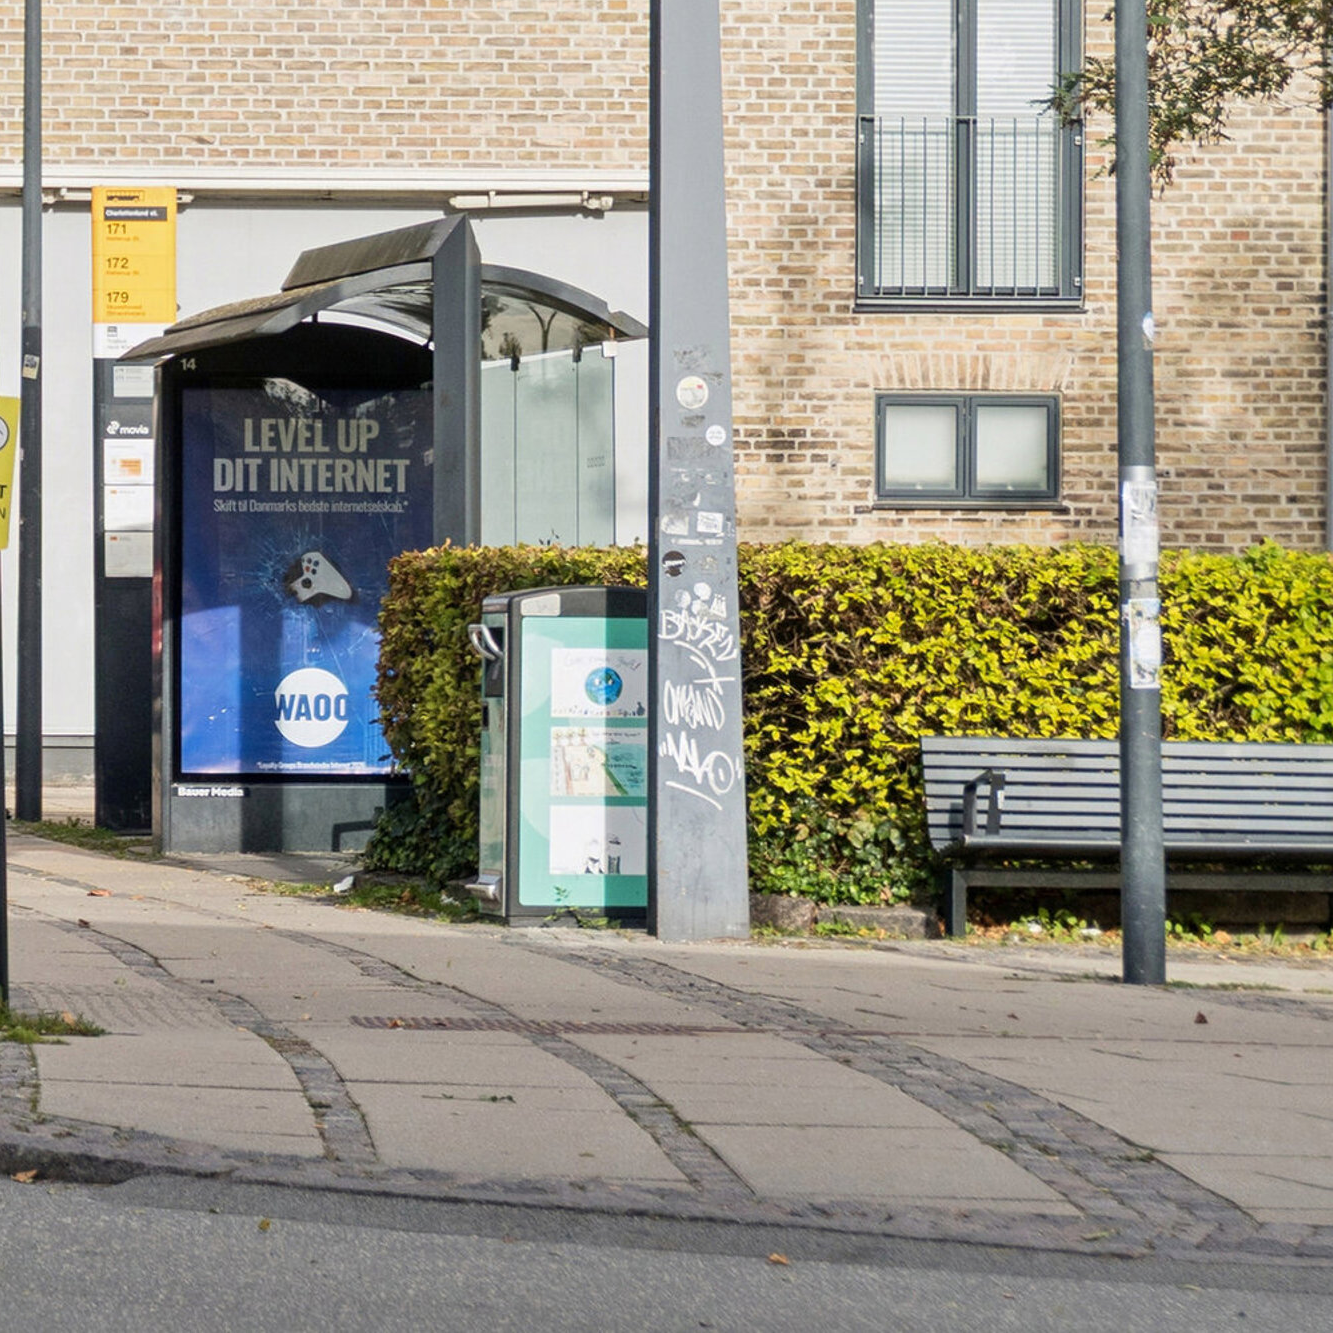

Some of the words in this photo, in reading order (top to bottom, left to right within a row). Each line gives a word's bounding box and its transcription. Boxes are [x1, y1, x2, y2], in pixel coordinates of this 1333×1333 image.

[107, 223, 127, 235] 171
[106, 257, 129, 269] 172
[106, 291, 129, 303] 179
[180, 358, 197, 370] 14
[120, 424, 149, 435] movia
[244, 418, 330, 453] LEVEL
[337, 419, 380, 453] UP
[213, 458, 262, 492] DIT
[270, 458, 410, 493] INTERNET
[214, 499, 236, 512] Skift
[238, 499, 248, 512] til
[249, 499, 297, 512] Danmarks
[298, 500, 330, 513] bedste
[211, 787, 244, 797] Media
